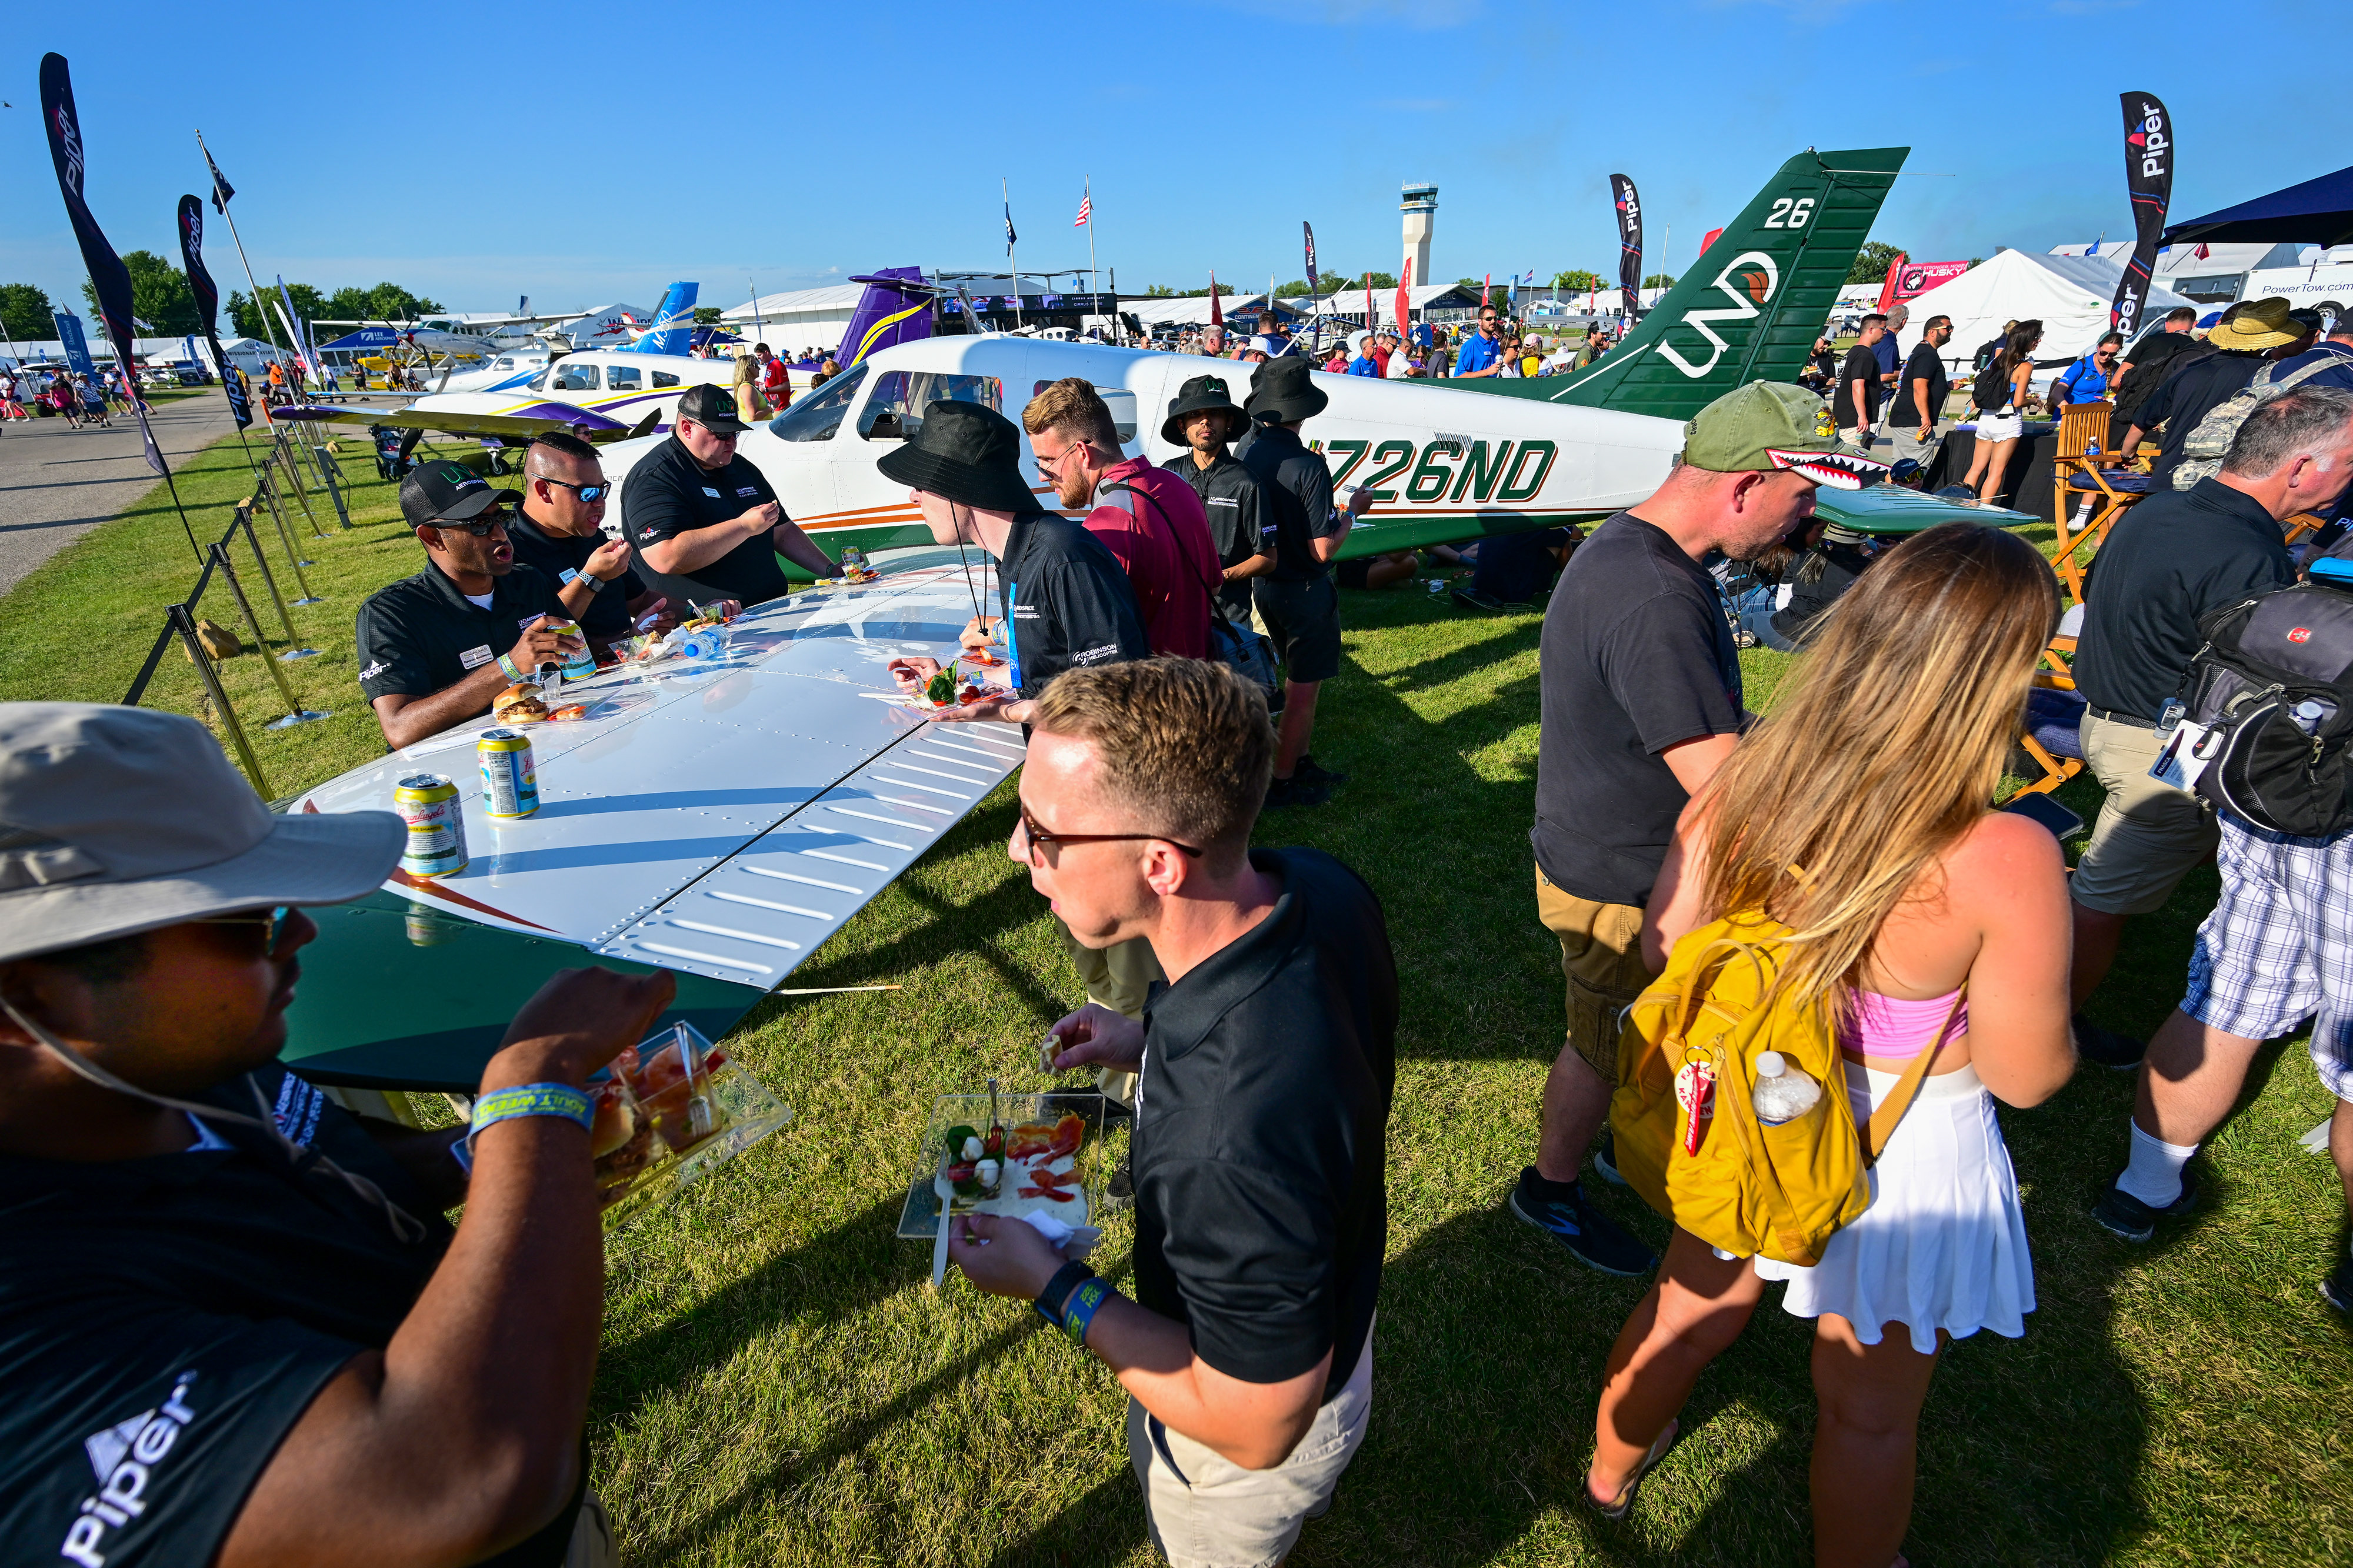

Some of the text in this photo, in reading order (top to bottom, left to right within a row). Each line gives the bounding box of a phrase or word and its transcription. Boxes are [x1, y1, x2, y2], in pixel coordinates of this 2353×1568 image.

[59, 104, 85, 198] Piper
[2142, 106, 2169, 178] Piper
[1624, 184, 1639, 232] Piper
[1764, 198, 1815, 228] 26
[188, 206, 202, 268] Piper
[1922, 269, 1963, 278] HUSKY
[2262, 283, 2353, 294] PowerTow.com
[1621, 306, 1632, 341] per
[1654, 251, 1779, 379] UND
[2118, 286, 2138, 336] per
[652, 310, 673, 350] M350
[222, 355, 246, 422] Piper
[1309, 440, 1558, 503] 726ND
[639, 529, 658, 541] Piper
[1081, 643, 1117, 658] ROBINSON
[1089, 649, 1118, 661] HELICOPTER
[359, 665, 387, 682] Piper
[2157, 756, 2172, 774] FRASCA
[397, 805, 446, 825] Linenkugel's
[61, 1384, 196, 1568] Piper
